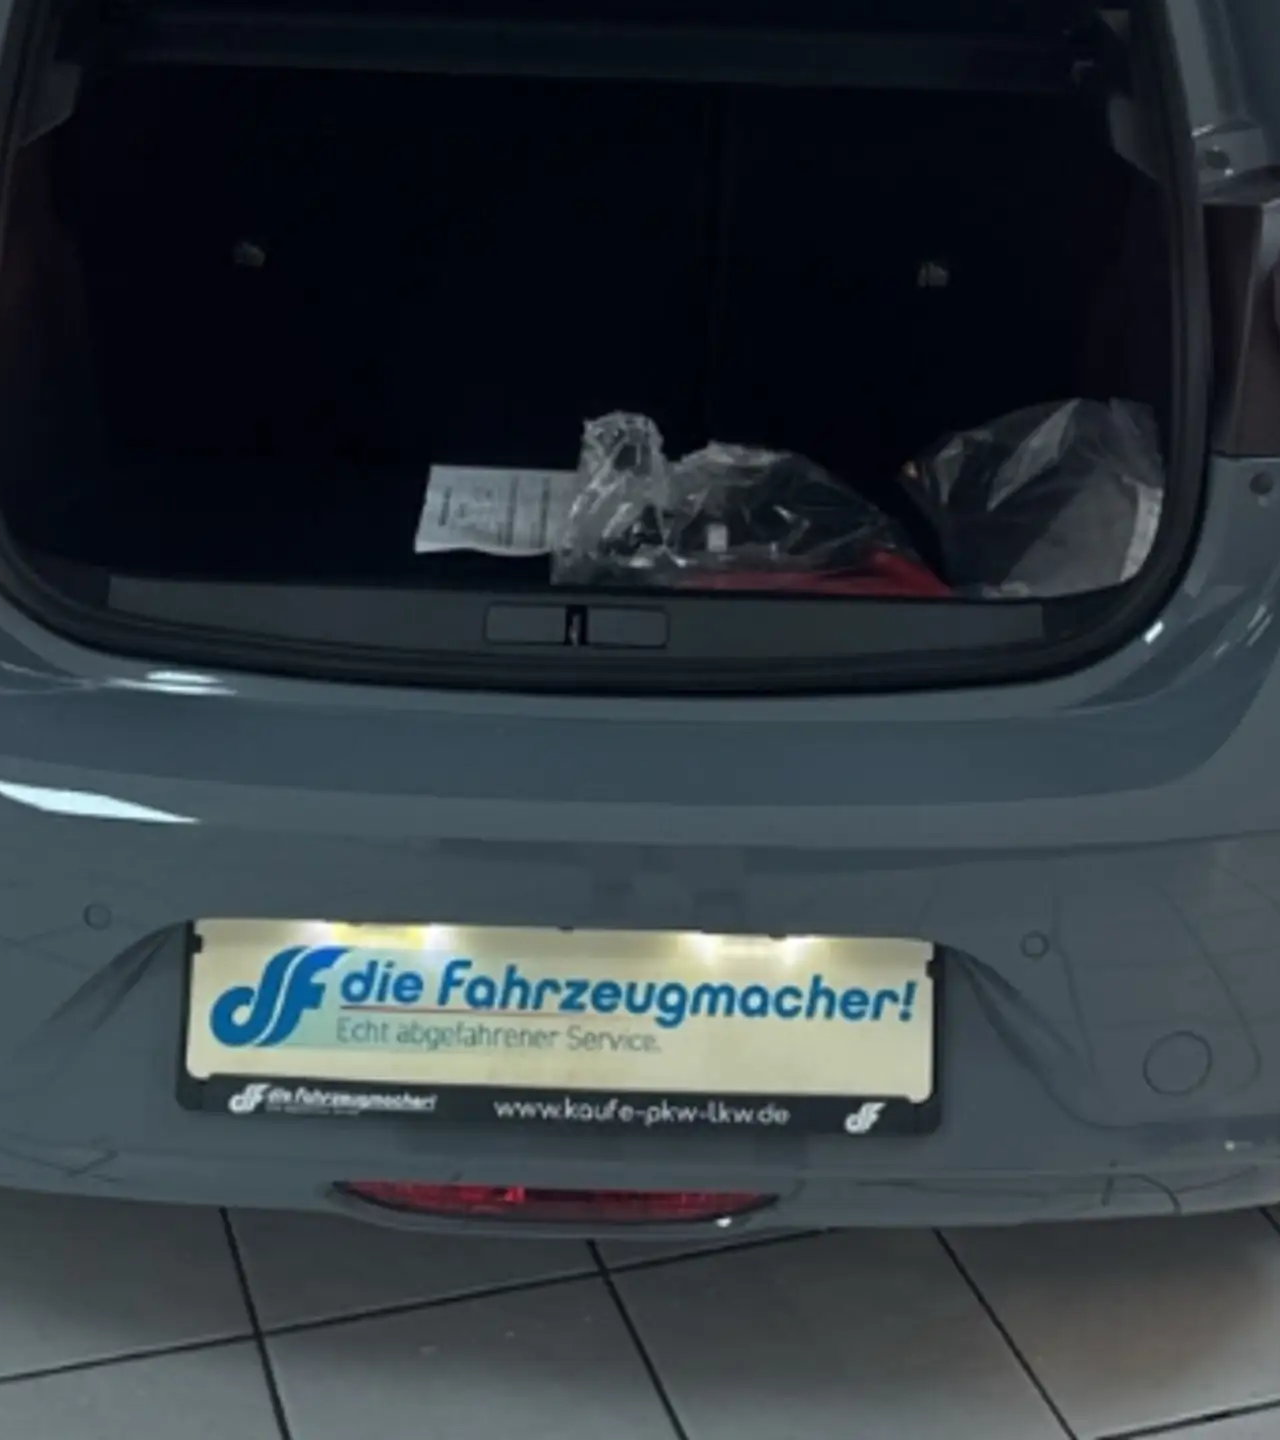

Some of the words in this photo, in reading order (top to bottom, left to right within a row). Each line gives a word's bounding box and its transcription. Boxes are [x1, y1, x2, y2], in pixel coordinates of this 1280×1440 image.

[339, 959, 424, 1003] die
[437, 959, 917, 1029] Fahrzeugmacher!
[336, 1017, 390, 1045] Echt
[396, 1020, 559, 1053] abgefahrener
[566, 1024, 663, 1054] Service.
[493, 1097, 791, 1127] www.kaufe-pkw-lkw.de
